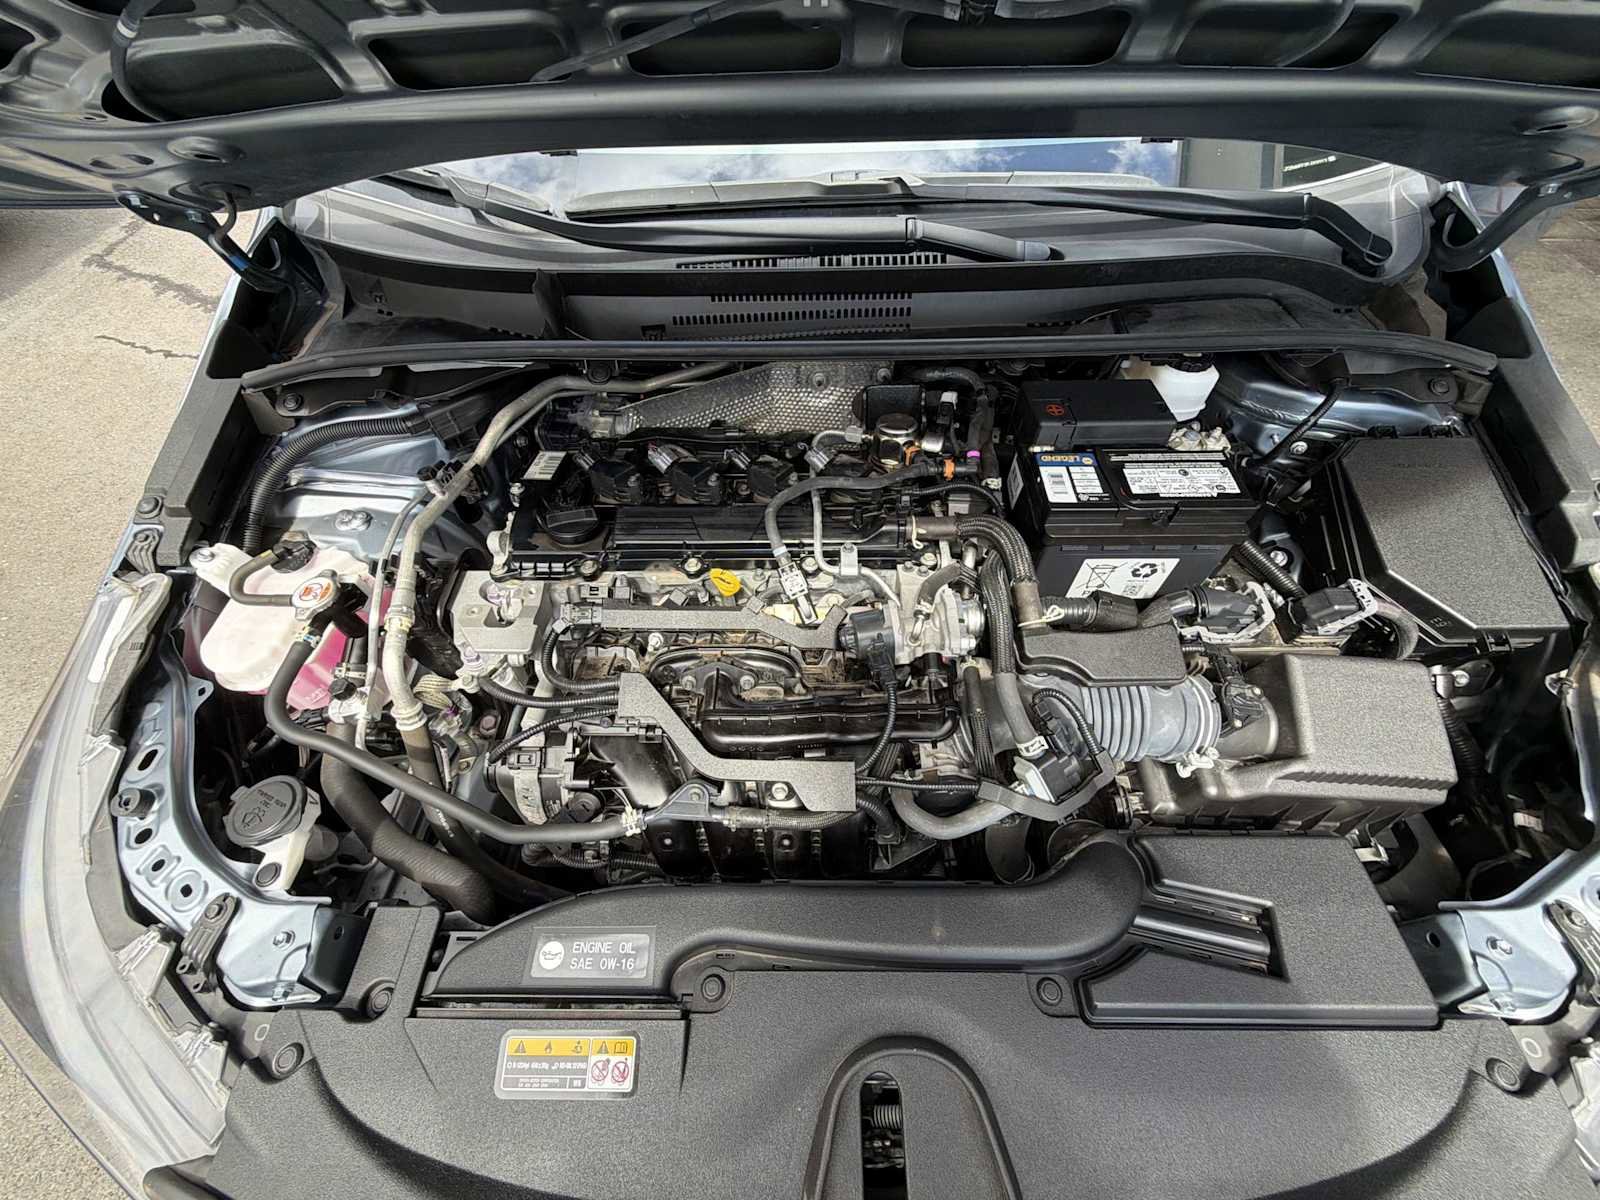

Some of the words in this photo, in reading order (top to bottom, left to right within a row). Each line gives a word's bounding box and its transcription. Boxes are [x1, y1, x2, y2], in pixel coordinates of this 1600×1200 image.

[572, 941, 613, 954] ENGINE
[619, 941, 637, 954] OIL
[569, 957, 593, 970] SAE
[600, 957, 635, 970] 0W-16
